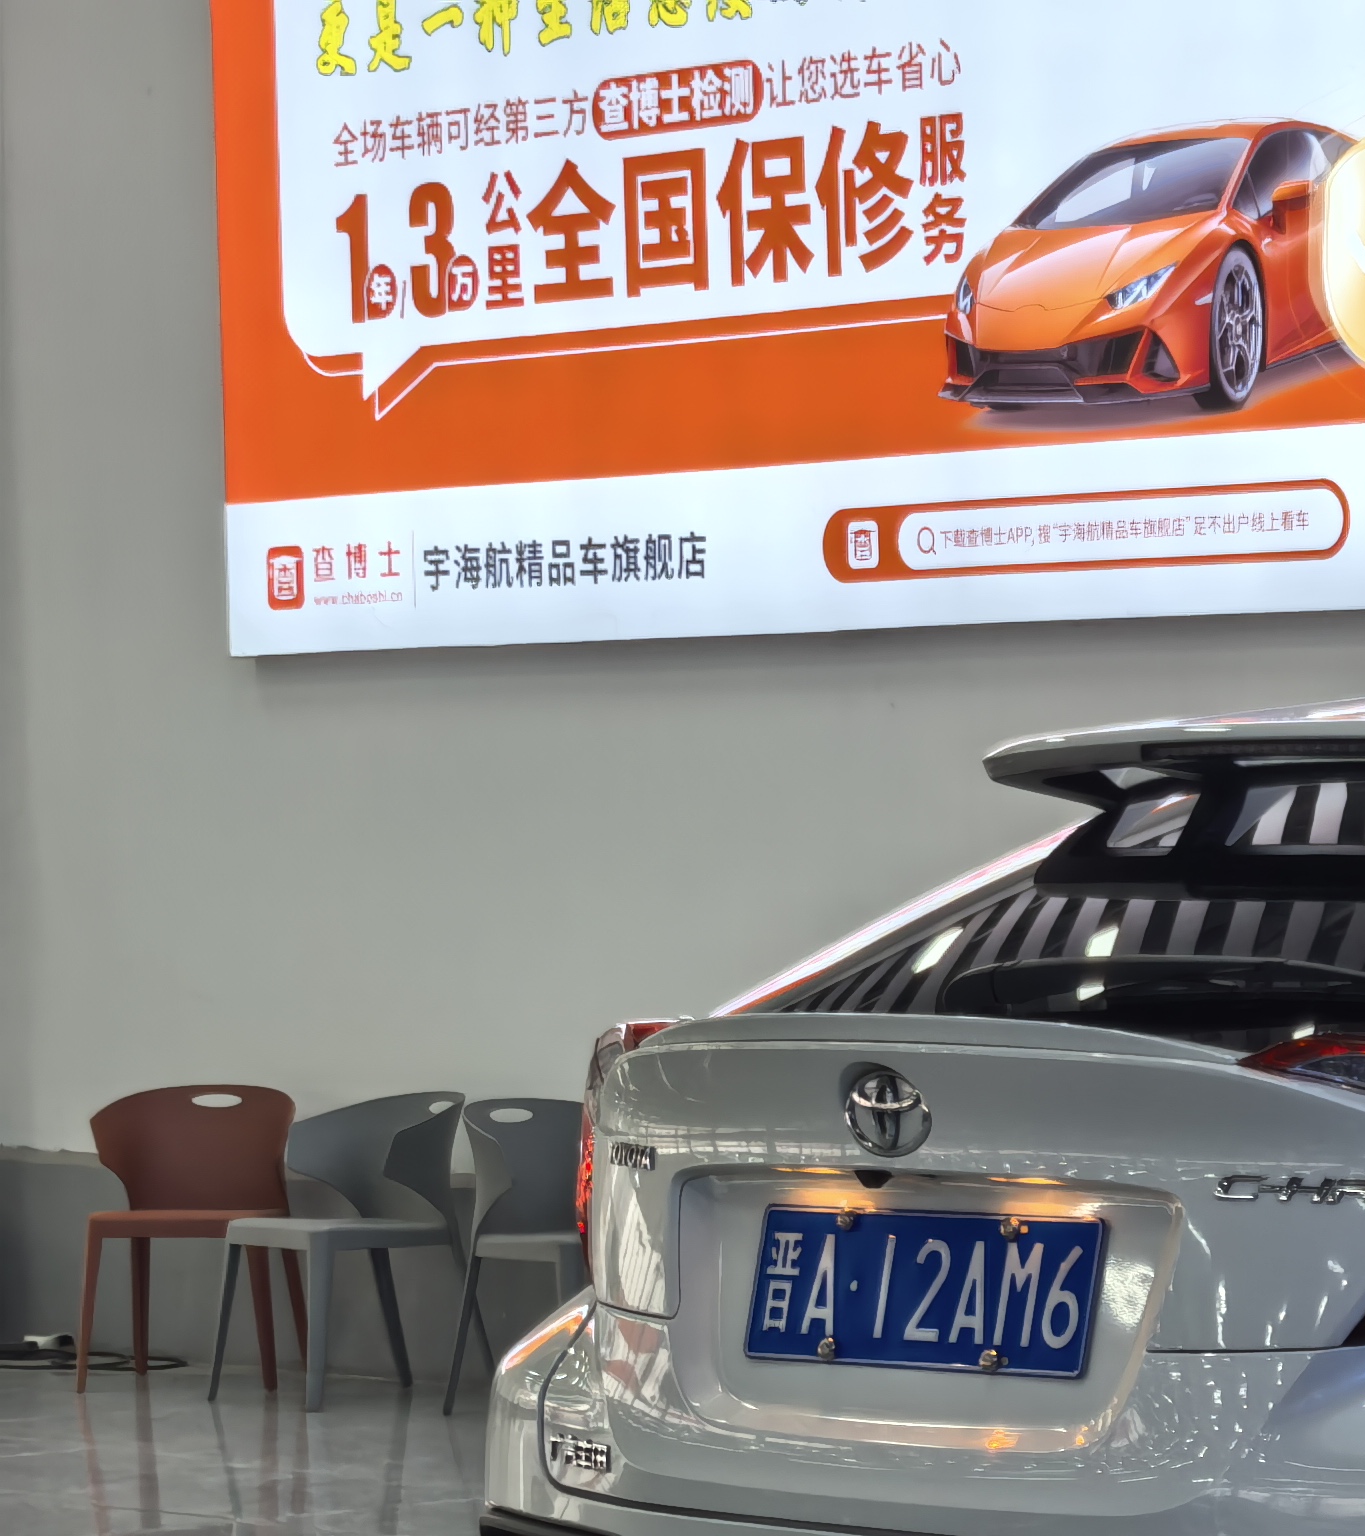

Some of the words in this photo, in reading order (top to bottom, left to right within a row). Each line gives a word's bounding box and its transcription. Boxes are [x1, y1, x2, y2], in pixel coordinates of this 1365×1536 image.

[311, 540, 401, 583] 查博士
[423, 530, 707, 592] 宇海航精品车旗舰店
